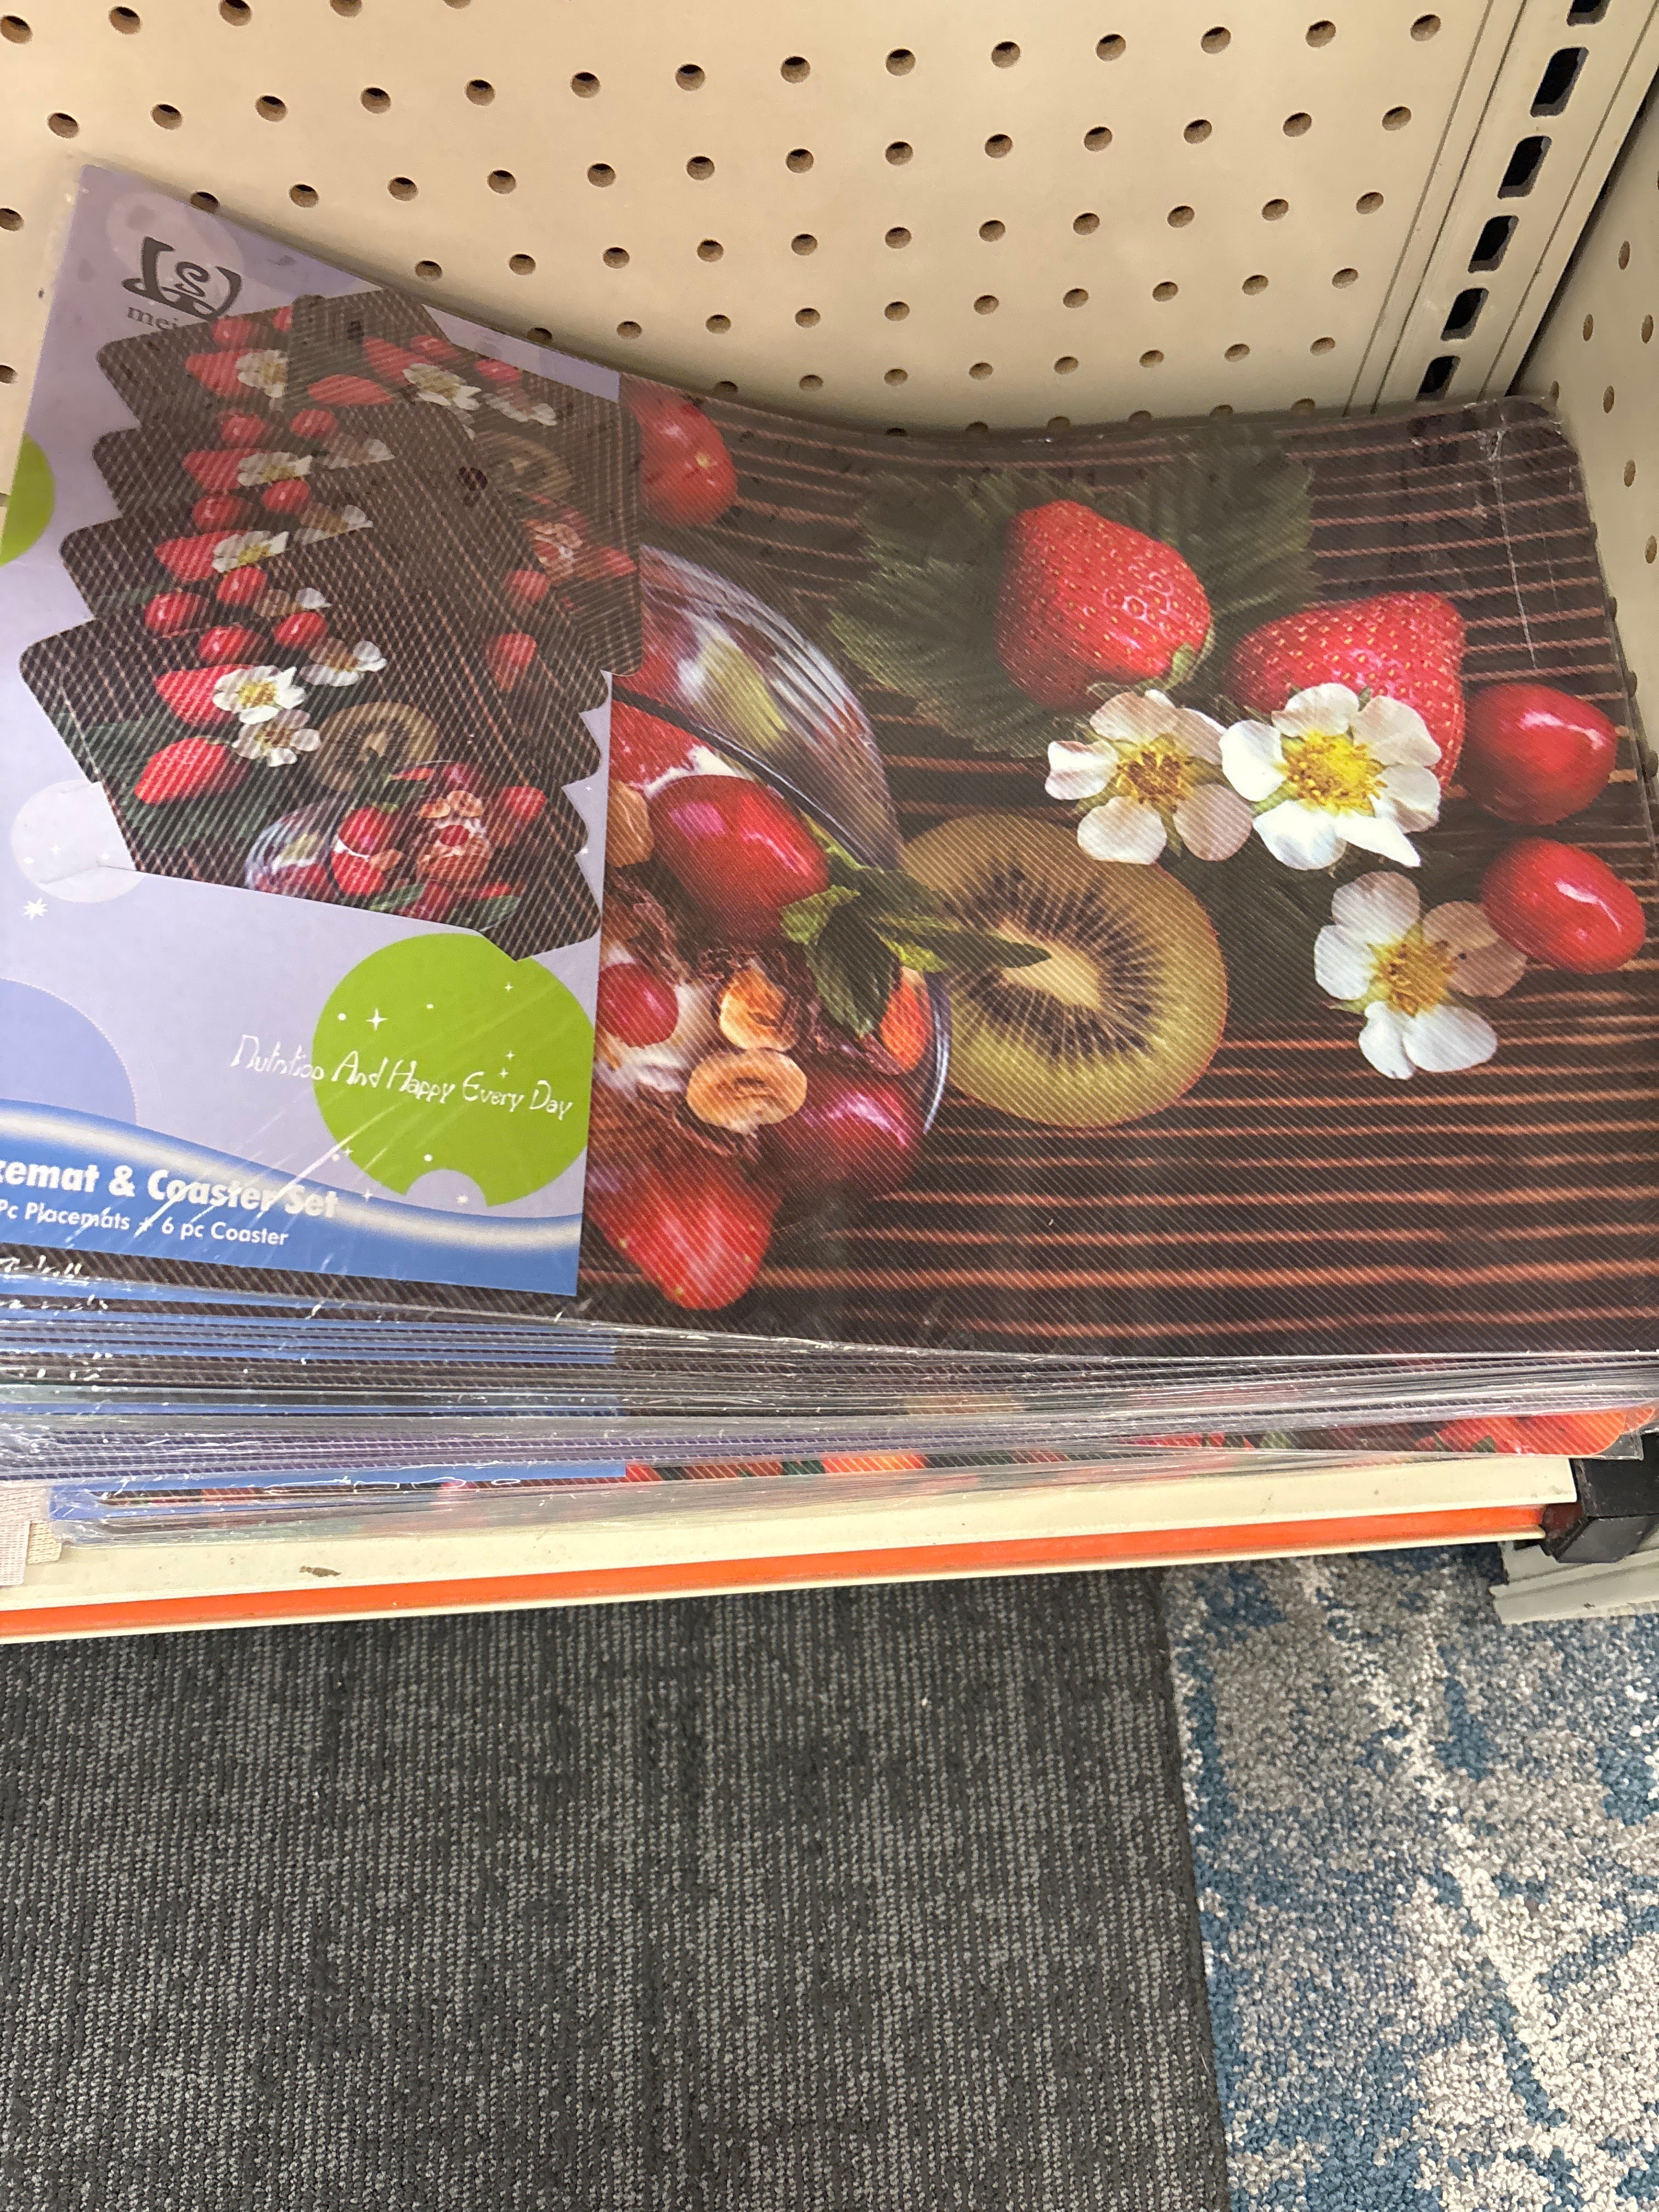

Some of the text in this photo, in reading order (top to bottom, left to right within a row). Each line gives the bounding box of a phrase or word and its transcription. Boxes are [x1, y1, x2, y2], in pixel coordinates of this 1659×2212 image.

[331, 1050, 388, 1088] And
[386, 1059, 455, 1103] Happy
[462, 1071, 524, 1112] Every
[529, 1080, 573, 1120] Day
[109, 1165, 135, 1197] &
[148, 1169, 276, 1211] Coaster
[284, 1184, 339, 1217] Set
[25, 1201, 130, 1231] Placemats
[162, 1216, 174, 1234] 6
[180, 1222, 205, 1240] pc
[211, 1221, 289, 1245] Coaster
